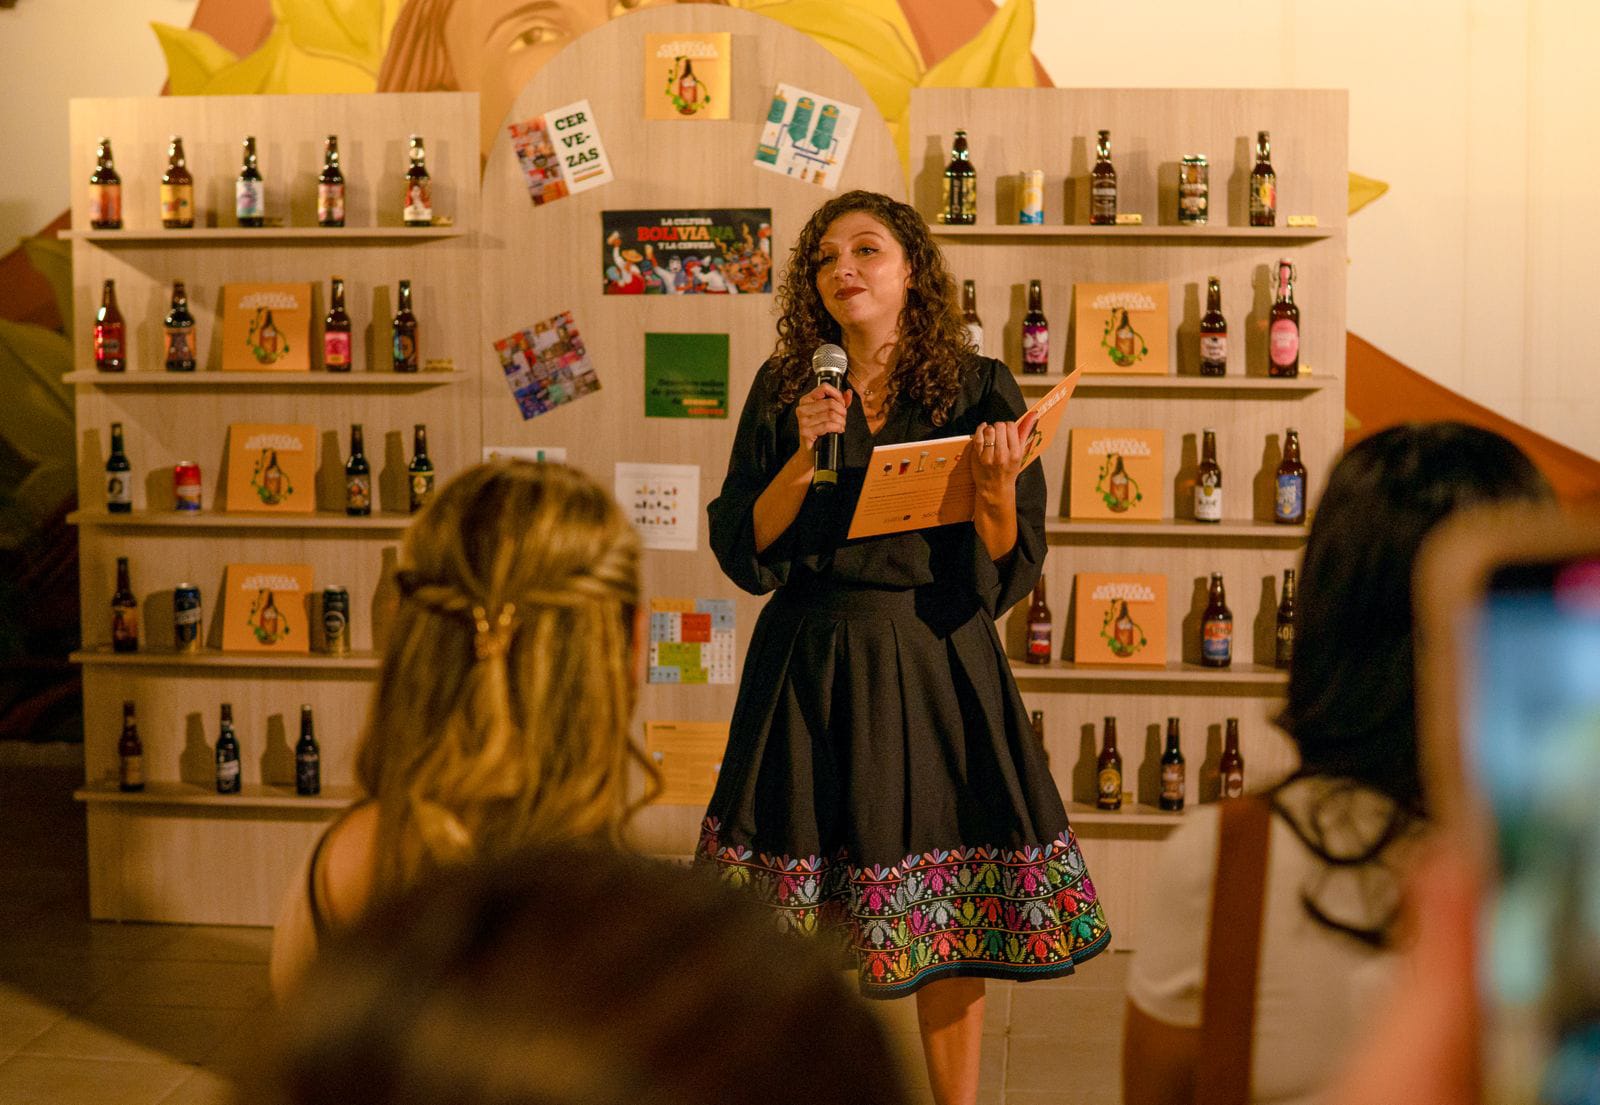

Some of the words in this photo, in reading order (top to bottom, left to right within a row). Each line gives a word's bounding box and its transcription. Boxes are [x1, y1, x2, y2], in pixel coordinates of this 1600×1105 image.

[555, 112, 587, 131] CER
[561, 132, 591, 148] VE-
[566, 148, 600, 168] ZAS
[661, 218, 673, 226] LA
[637, 226, 735, 241] BOLIVIANA
